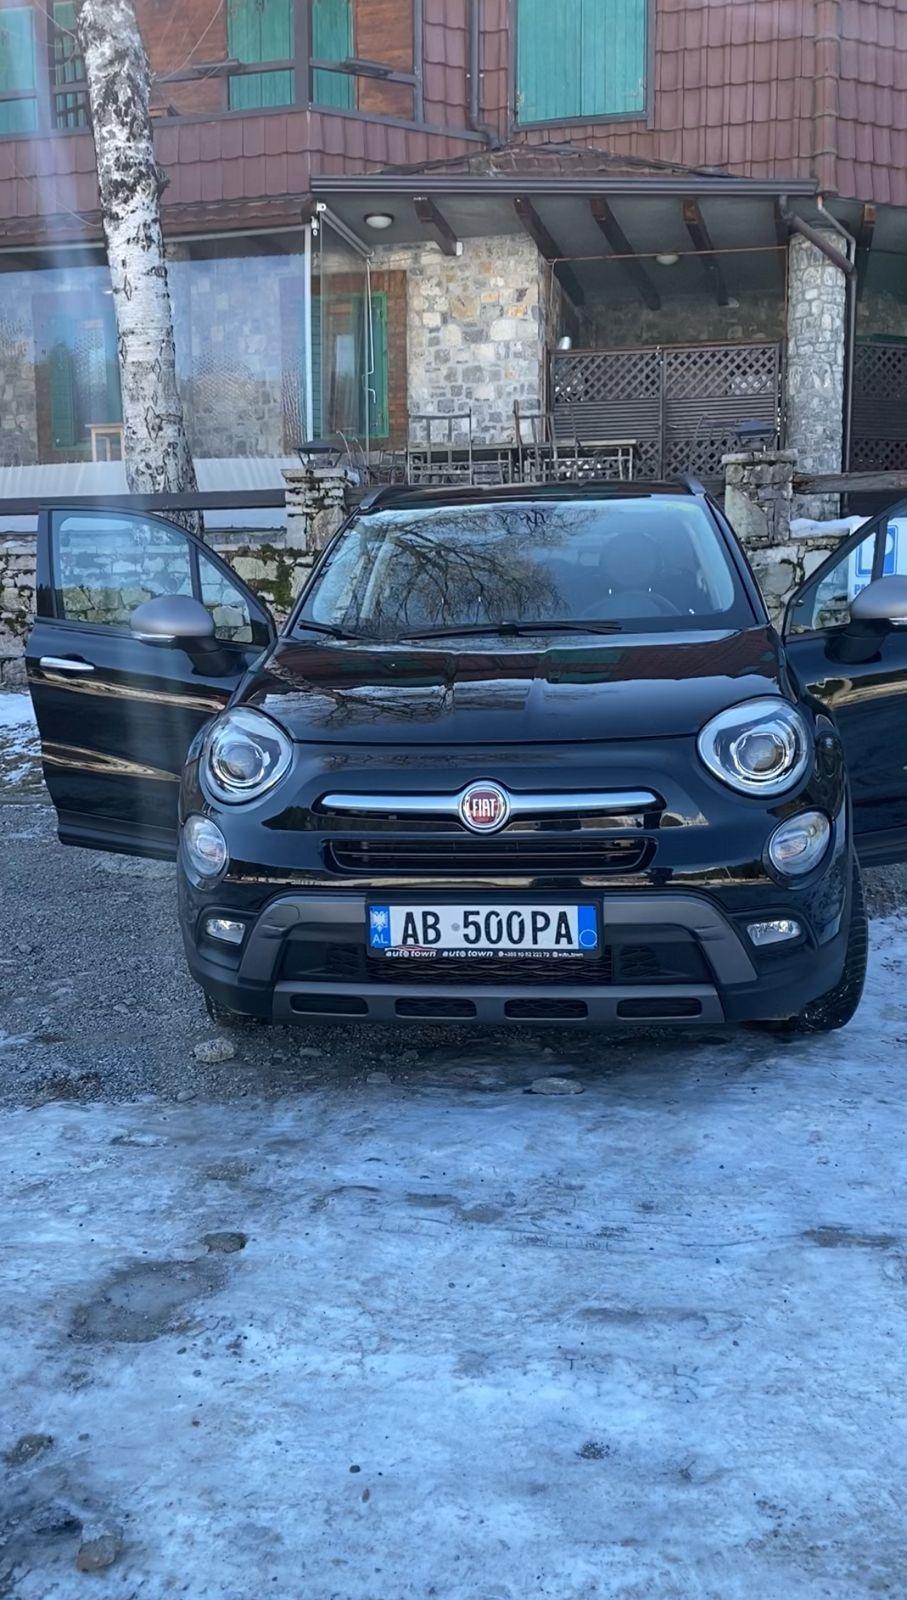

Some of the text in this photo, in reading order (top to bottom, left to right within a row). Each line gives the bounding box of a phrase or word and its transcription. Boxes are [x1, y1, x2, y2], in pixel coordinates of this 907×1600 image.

[472, 798, 496, 817] FIAT
[402, 910, 573, 945] AB 500PA
[372, 934, 389, 943] AL
